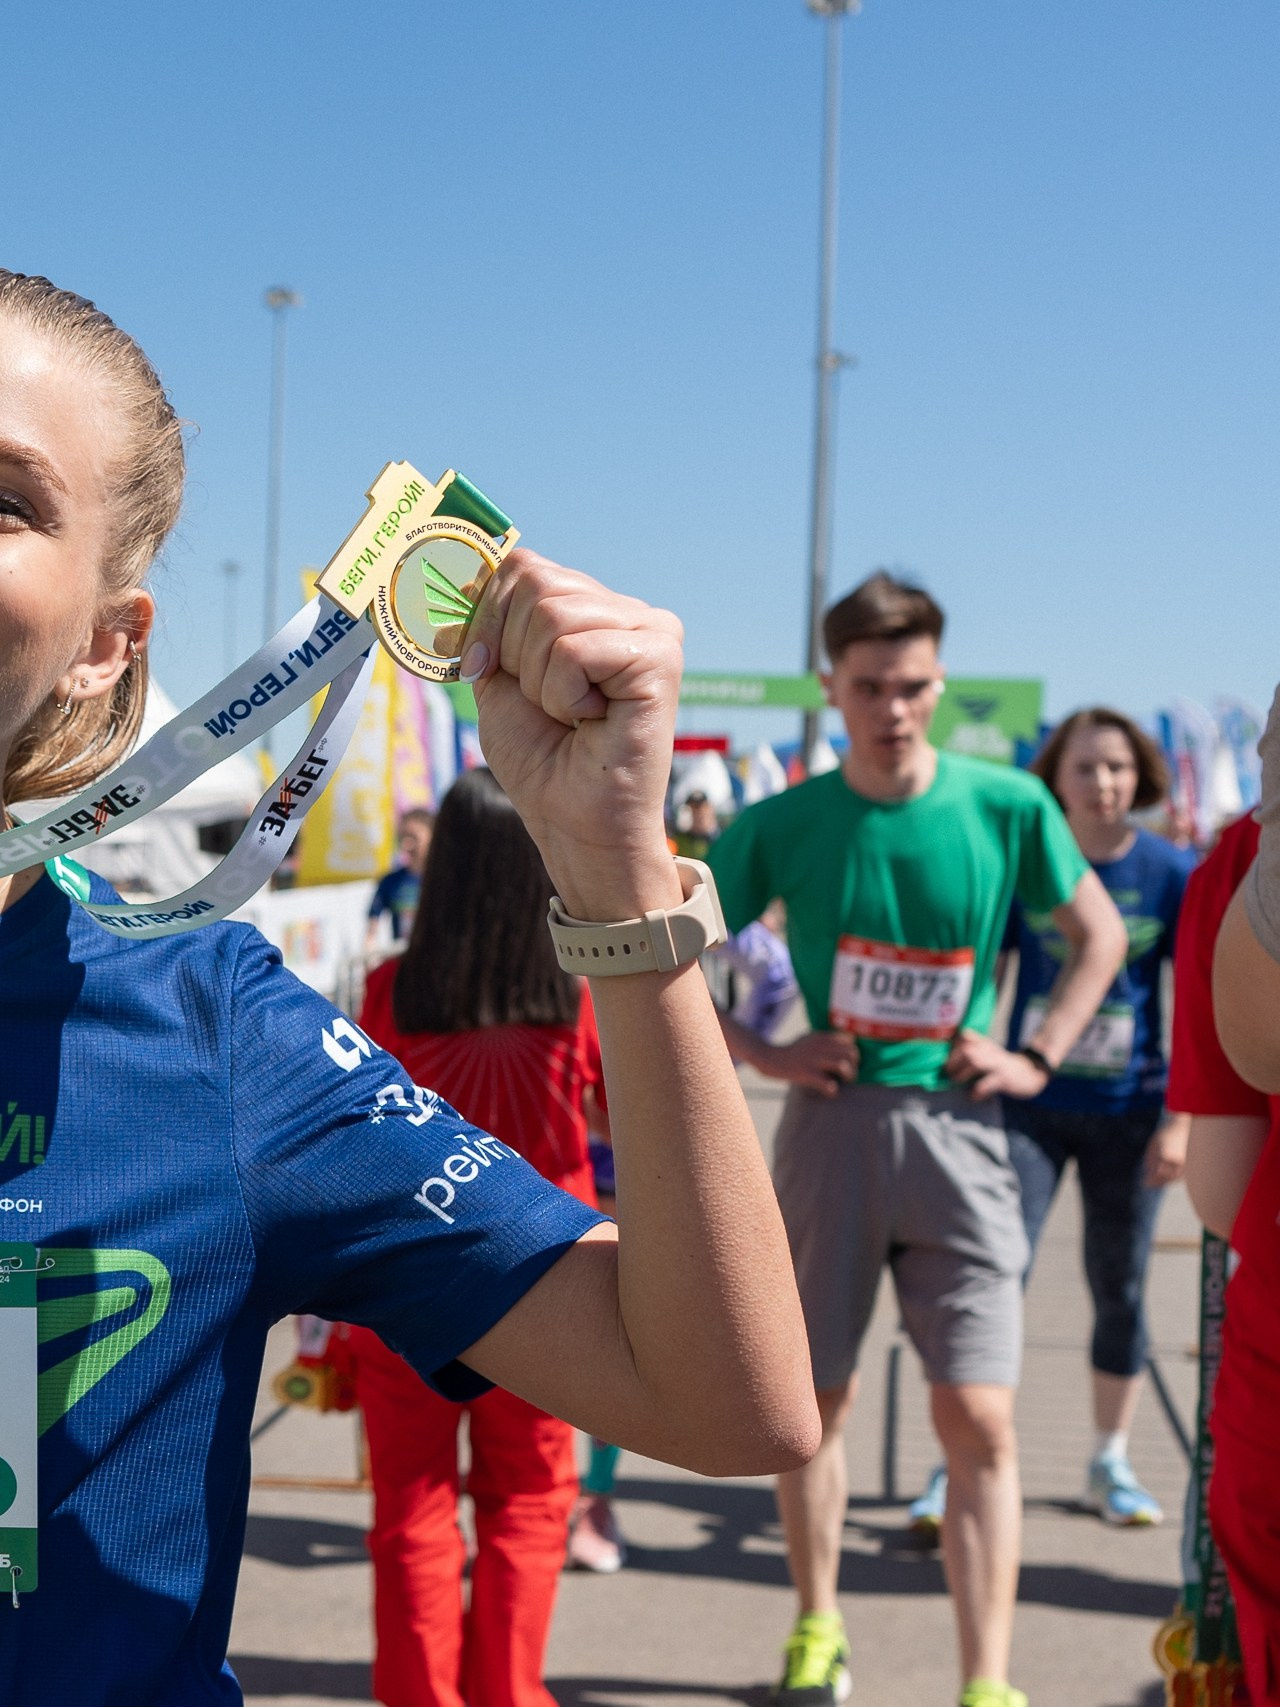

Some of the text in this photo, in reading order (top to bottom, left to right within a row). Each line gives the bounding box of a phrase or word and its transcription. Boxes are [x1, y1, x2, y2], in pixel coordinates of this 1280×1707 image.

[338, 480, 426, 597] БЕГИ, ГЕРОЙ!
[405, 522, 498, 556] БЛАГОТВОРИТЕЛЬНЫЙ
[378, 585, 460, 678] НИЖНИЙ НОВГОРОД 20
[204, 661, 298, 738] ГЕРОЙ!
